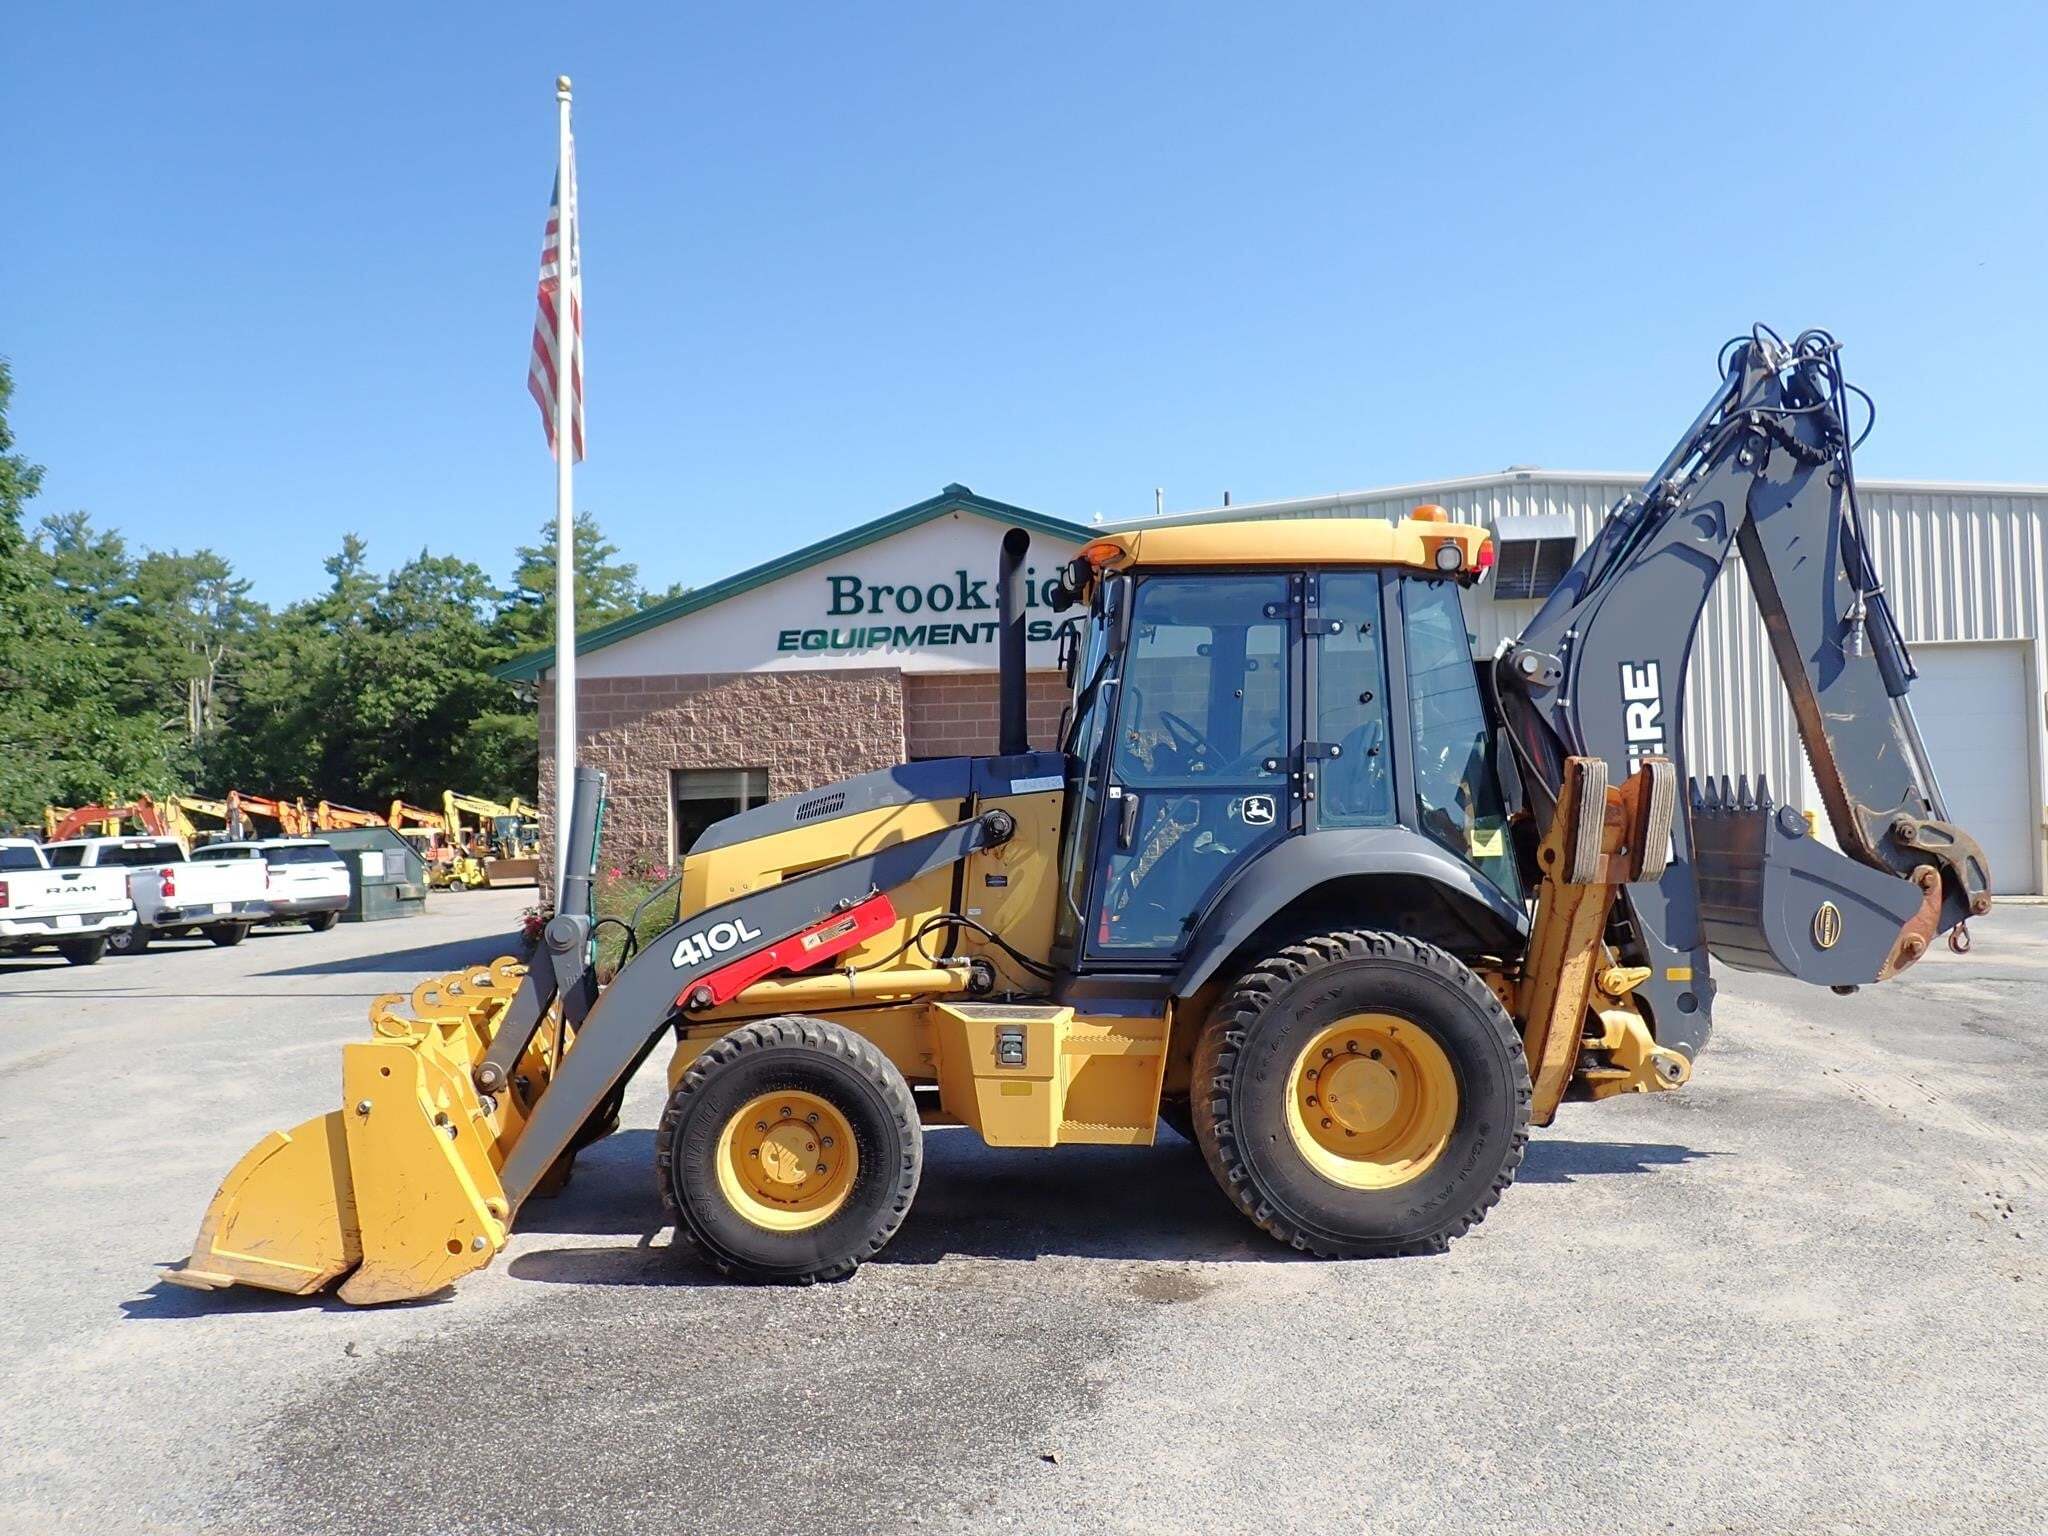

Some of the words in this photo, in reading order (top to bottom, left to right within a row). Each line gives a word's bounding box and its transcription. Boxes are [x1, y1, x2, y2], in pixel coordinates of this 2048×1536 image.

[777, 622, 1000, 651] EQUIPMENT
[45, 885, 97, 894] RAM
[671, 918, 762, 969] 410L
